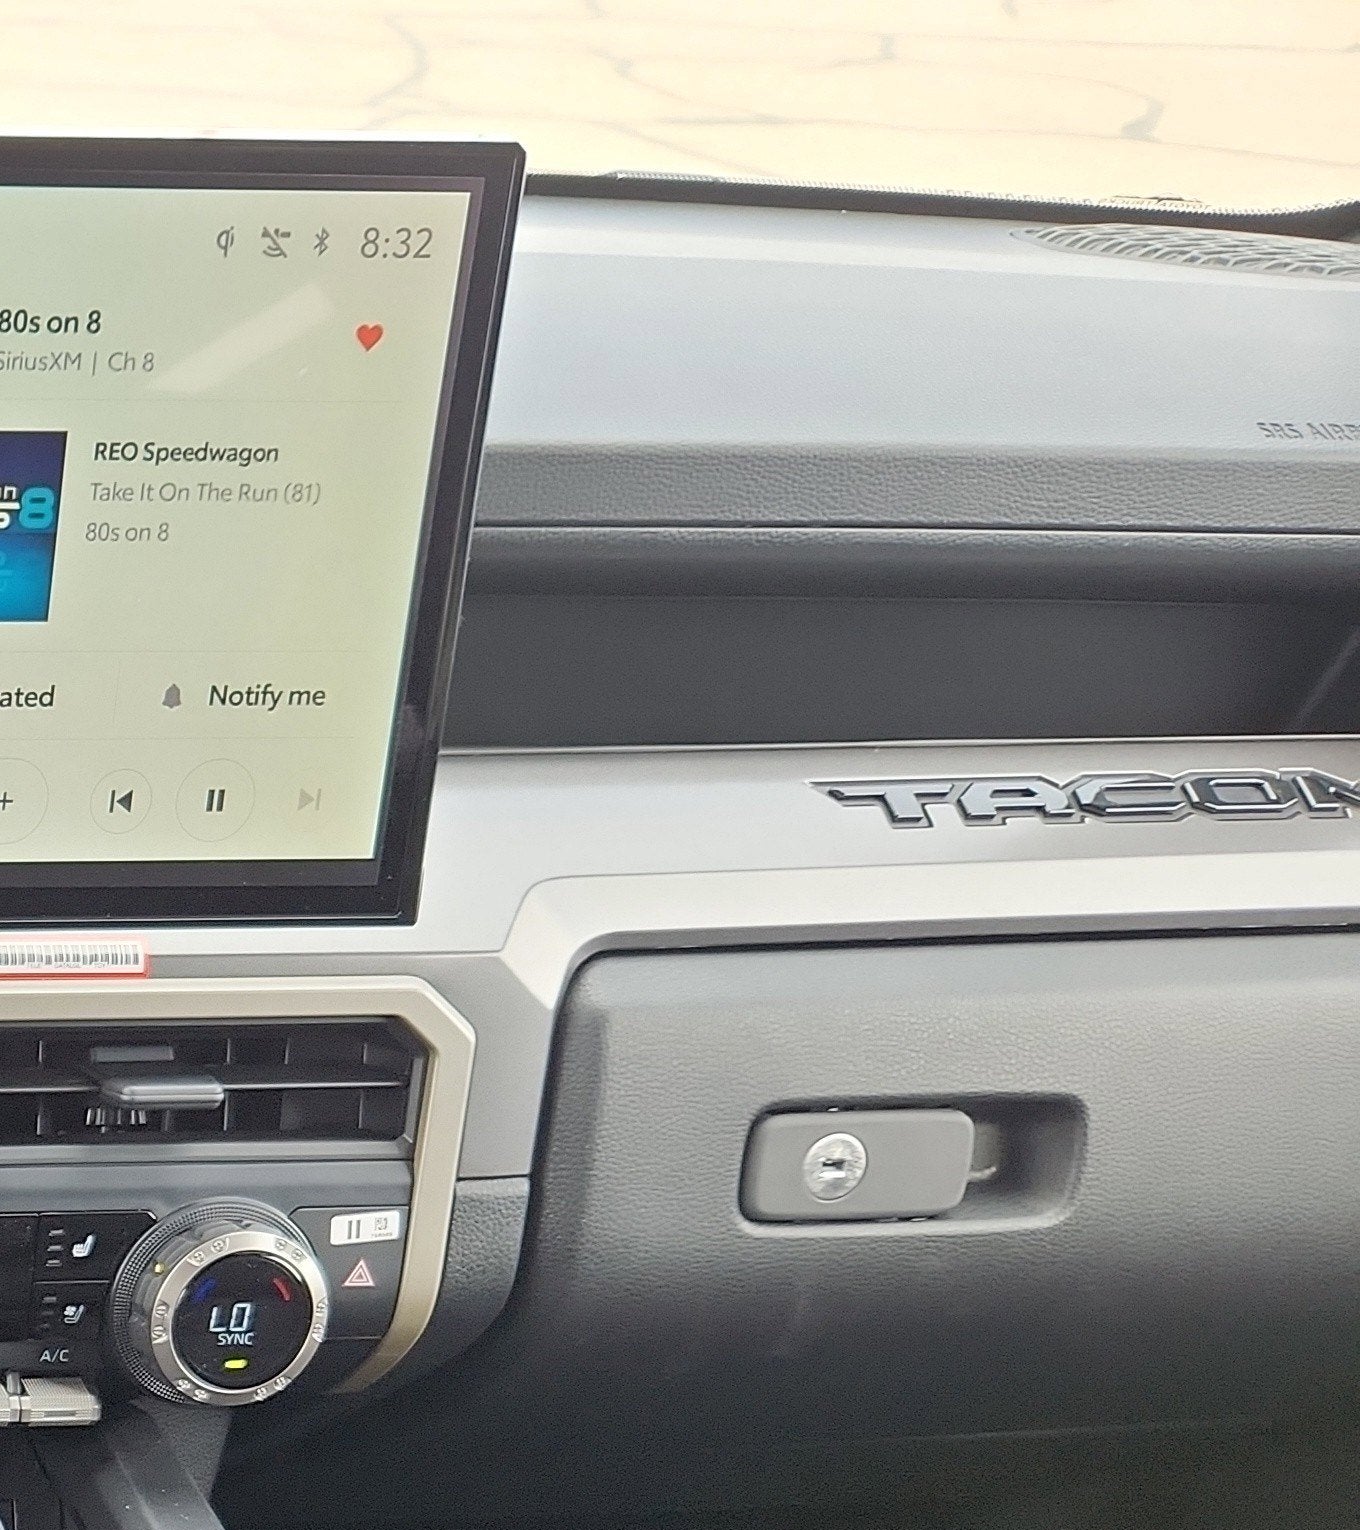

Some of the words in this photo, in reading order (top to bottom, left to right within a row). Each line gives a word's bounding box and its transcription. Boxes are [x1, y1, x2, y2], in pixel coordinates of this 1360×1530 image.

[360, 227, 433, 259] 8:32
[47, 315, 79, 333] on
[86, 310, 101, 334] 8
[108, 350, 136, 372] Ch
[142, 352, 155, 373] 8
[1256, 421, 1304, 439] SRS
[94, 442, 138, 463] REO
[142, 441, 279, 467] Speedwagon
[90, 481, 135, 503] Take
[140, 482, 153, 503] It
[159, 482, 190, 503] On
[196, 482, 233, 503] The
[238, 482, 278, 503] Run
[284, 481, 322, 507] (81)
[85, 522, 119, 542] 80s
[124, 527, 153, 542] on
[157, 522, 170, 542] 8
[208, 683, 282, 710] Notify
[288, 688, 326, 706] me
[209, 1302, 251, 1333] LO
[217, 1331, 254, 1346] SYNC
[39, 1349, 70, 1363] A/C
